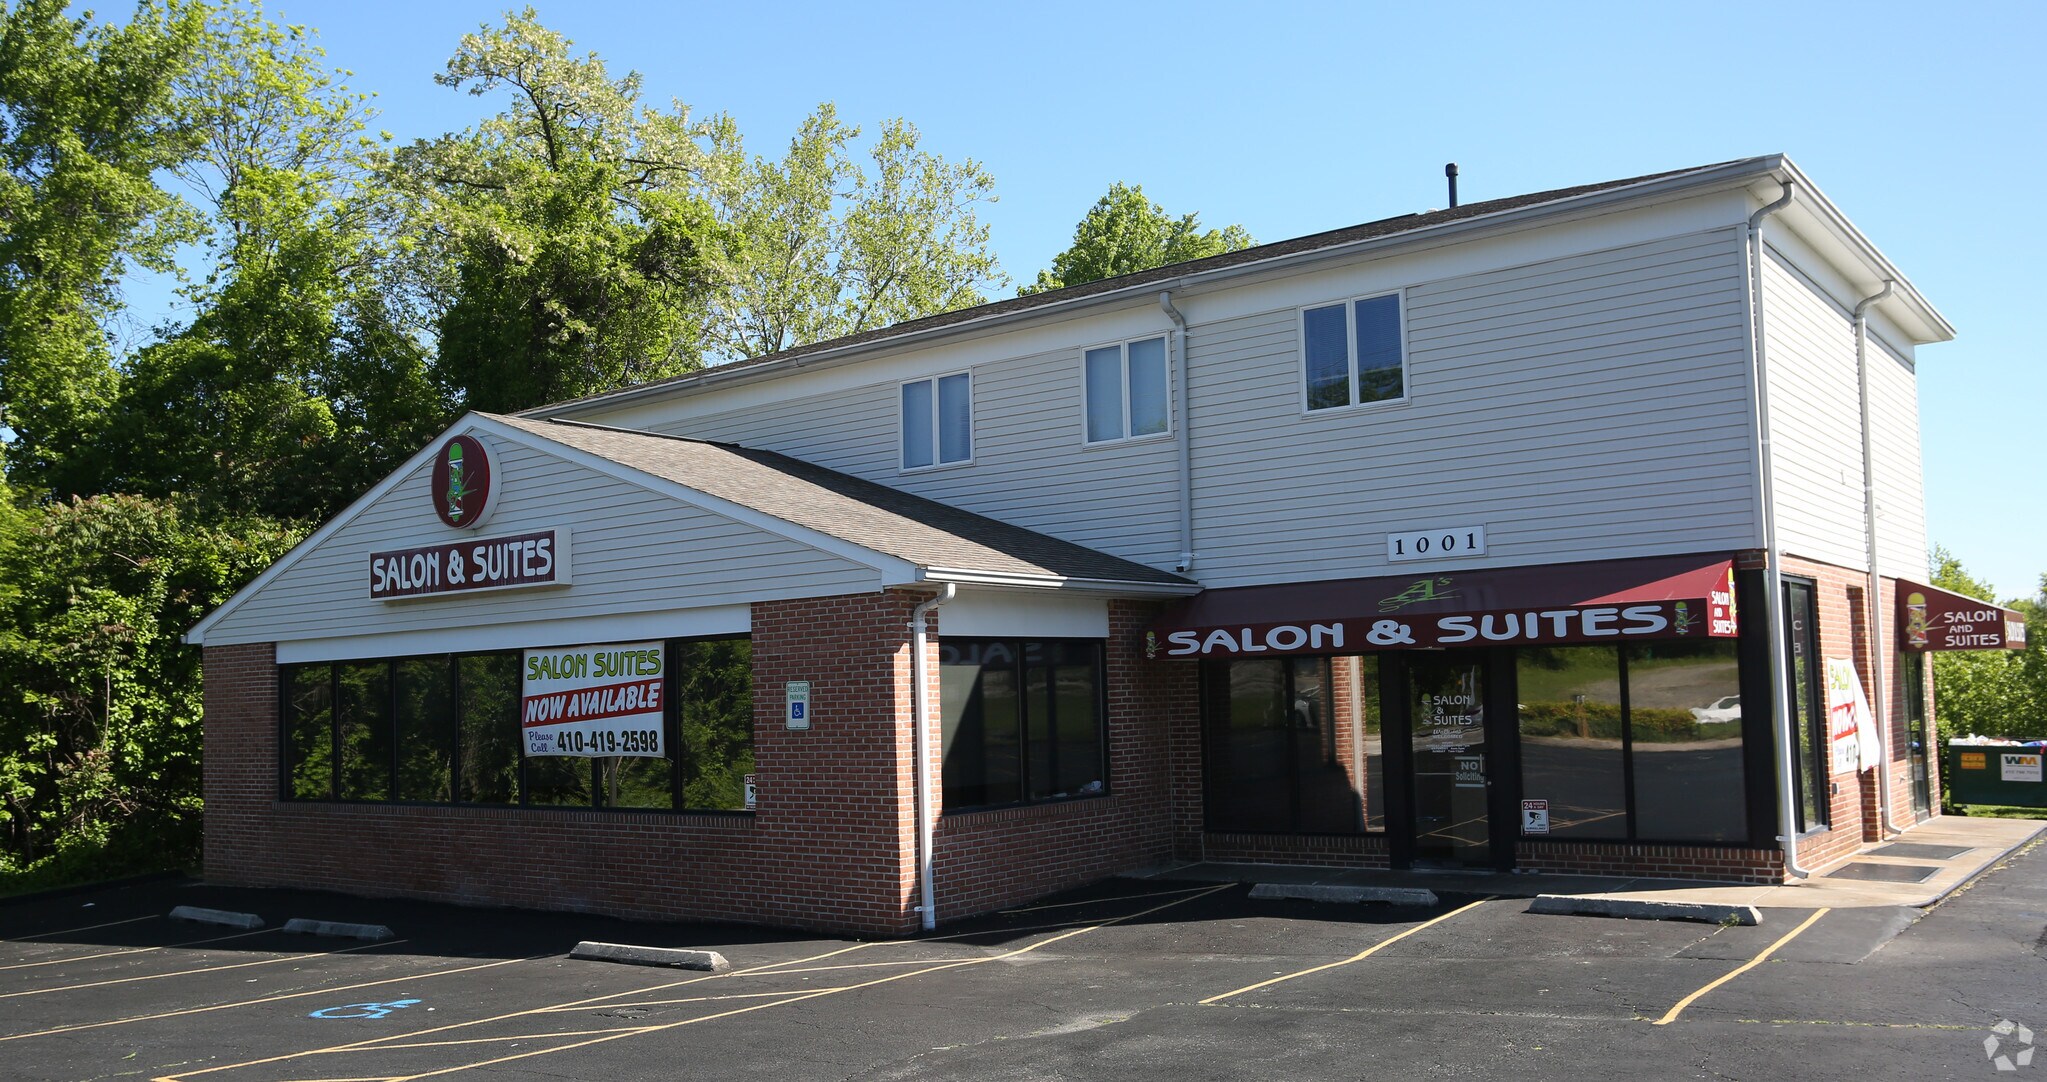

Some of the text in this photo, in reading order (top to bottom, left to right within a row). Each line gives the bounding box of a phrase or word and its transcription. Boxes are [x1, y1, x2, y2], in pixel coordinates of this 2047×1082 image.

[1395, 533, 1476, 555] 1001
[373, 538, 552, 592] SALON & SUITES
[1711, 590, 1730, 606] SALON
[1944, 610, 1997, 624] SALON
[1167, 605, 1668, 655] SALON & SUITES
[1713, 619, 1732, 634] SUITES
[1949, 624, 1973, 634] AND
[1945, 633, 2000, 647] SUITES
[527, 649, 662, 680] SALON SUITES
[787, 685, 808, 693] RESERVED
[525, 682, 661, 723] NOW AVAILABLE
[789, 693, 806, 701] PARKING
[1433, 695, 1470, 705] SALON
[1436, 706, 1444, 715] &
[1434, 715, 1472, 726] SUITES
[528, 731, 553, 741] Please
[557, 730, 659, 753] 410-419-2598
[1461, 761, 1478, 770] NO
[2004, 756, 2038, 765] WM
[746, 776, 753, 784] 24
[1455, 771, 1484, 783] Soliciting
